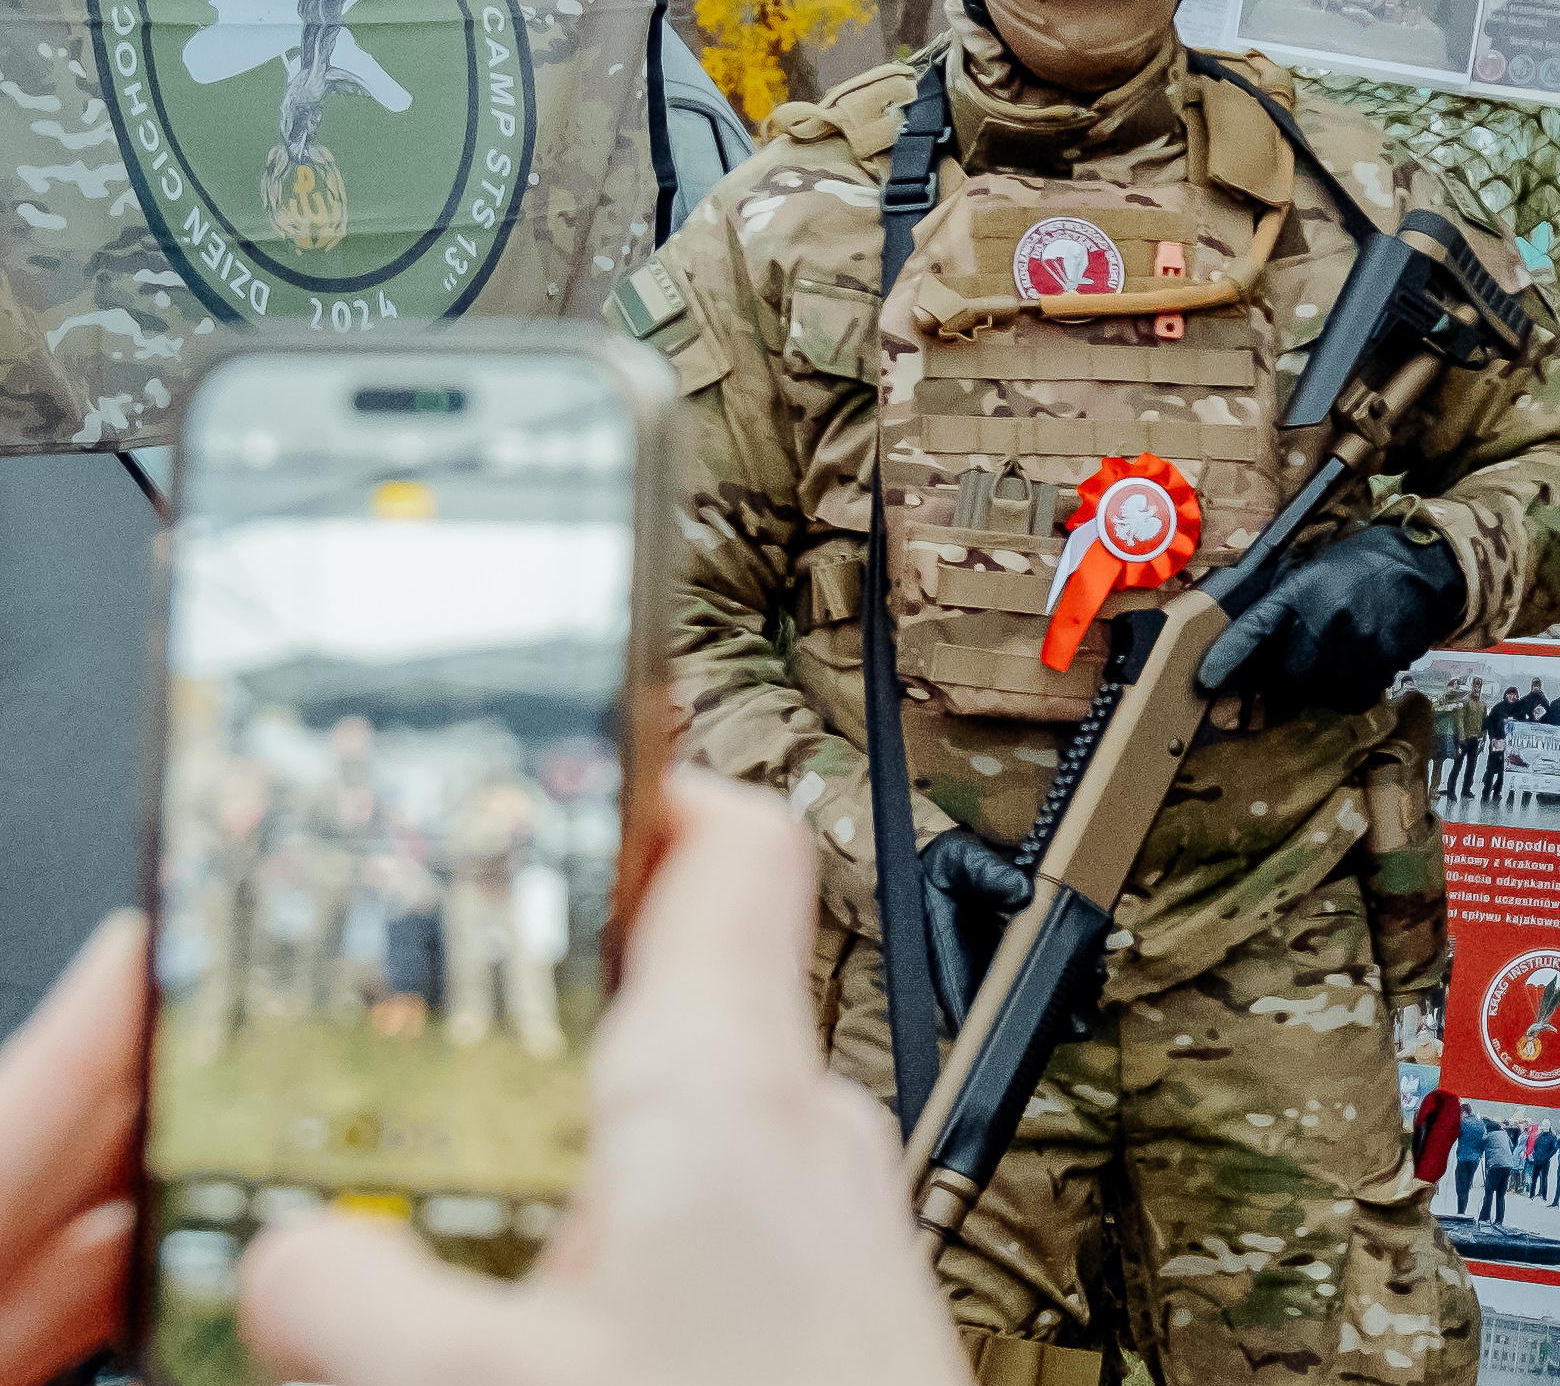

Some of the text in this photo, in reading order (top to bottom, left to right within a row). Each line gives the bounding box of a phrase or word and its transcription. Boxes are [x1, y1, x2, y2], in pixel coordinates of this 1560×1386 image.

[181, 205, 273, 317] DZIEŃ
[470, 148, 513, 231] STS
[309, 288, 400, 335] 2024
[1462, 833, 1486, 848] dla
